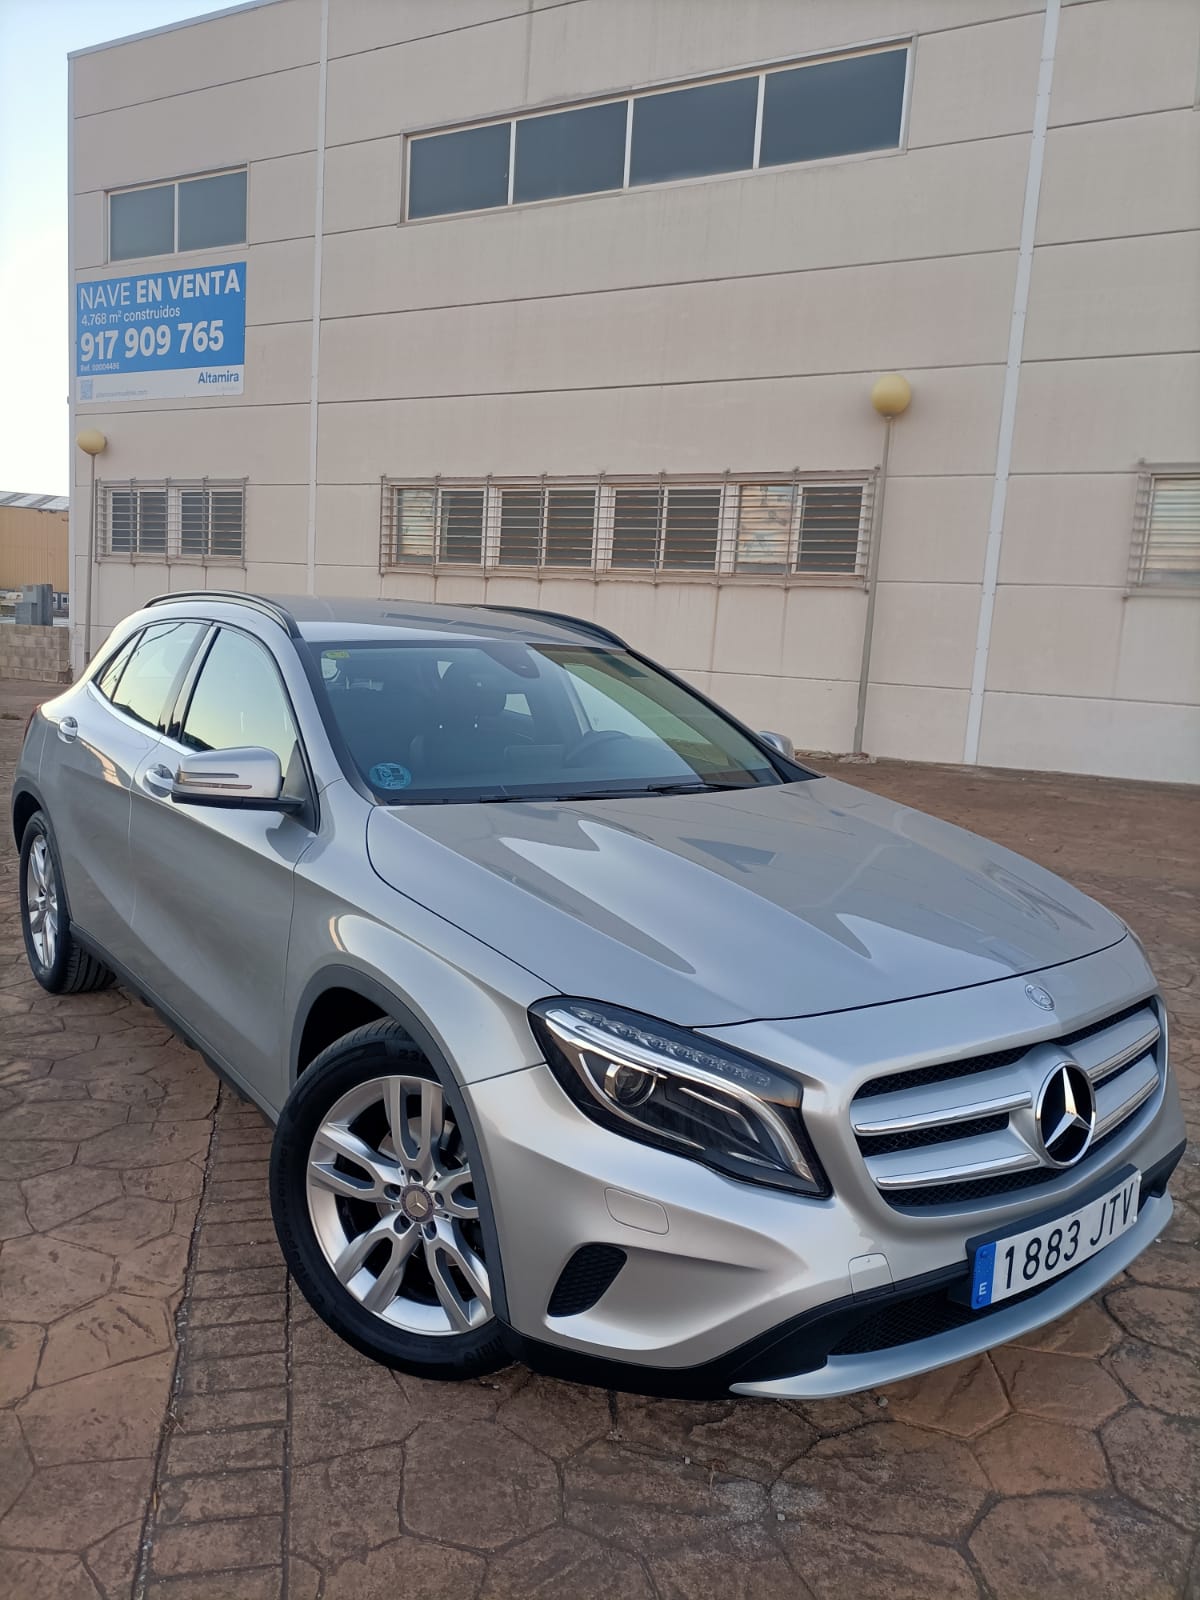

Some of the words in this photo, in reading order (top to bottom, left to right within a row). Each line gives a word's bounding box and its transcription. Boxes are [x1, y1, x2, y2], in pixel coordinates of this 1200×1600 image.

[80, 282, 130, 310] NAVE
[136, 278, 162, 304] EN
[168, 269, 240, 299] VENTA
[124, 304, 180, 322] construidos
[80, 329, 119, 362] 917
[124, 324, 171, 358] 909
[177, 319, 224, 352] 765
[198, 370, 240, 384] Altamira
[1005, 1219, 1081, 1290] 1883
[1090, 1182, 1135, 1245] JTV
[979, 1282, 987, 1295] E
